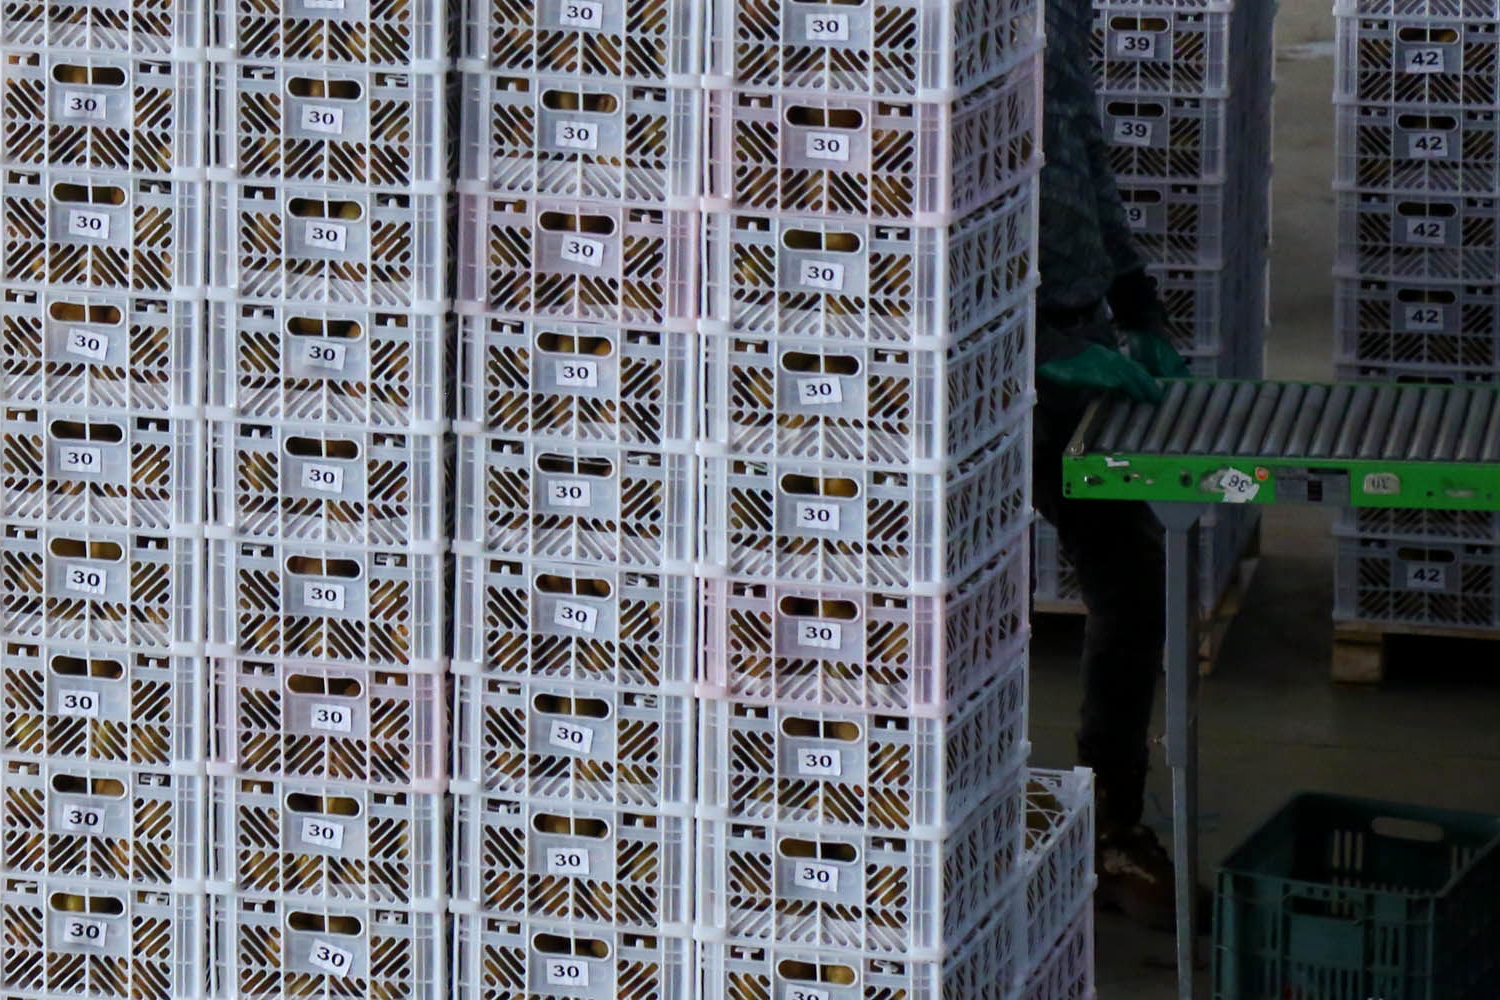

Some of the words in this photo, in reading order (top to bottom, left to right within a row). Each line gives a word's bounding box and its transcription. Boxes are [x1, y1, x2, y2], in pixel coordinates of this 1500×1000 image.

[567, 4, 593, 20] 30
[813, 19, 839, 32] 30
[1124, 35, 1150, 51] 39
[1412, 50, 1438, 66] 42
[71, 97, 97, 111] 30
[309, 110, 334, 124] 30
[564, 126, 589, 141] 30
[1121, 121, 1147, 138] 39
[814, 137, 840, 152] 30
[1415, 135, 1442, 150] 42
[77, 215, 101, 230] 30
[1413, 222, 1440, 237] 42
[312, 227, 338, 241] 30
[568, 240, 594, 257] 30
[808, 265, 834, 281] 30
[1412, 308, 1438, 323] 42
[75, 333, 100, 352] 30
[309, 345, 335, 361] 30
[564, 365, 589, 379] 30
[806, 382, 832, 395] 30
[69, 451, 93, 465] 30
[309, 468, 335, 484] 30
[556, 485, 582, 498] 30
[804, 507, 830, 522] 30
[73, 569, 100, 586] 30
[1413, 567, 1440, 582] 42
[312, 587, 337, 601] 30
[563, 606, 587, 623] 30
[806, 625, 832, 640] 30
[65, 694, 92, 709] 30
[318, 709, 343, 724] 30
[557, 726, 583, 743] 30
[806, 753, 832, 767] 30
[70, 810, 98, 826] 30
[310, 823, 334, 839] 30
[555, 853, 580, 866] 30
[803, 867, 829, 882] 30
[71, 922, 99, 939] 30
[317, 946, 344, 967] 30
[554, 964, 579, 978] 30
